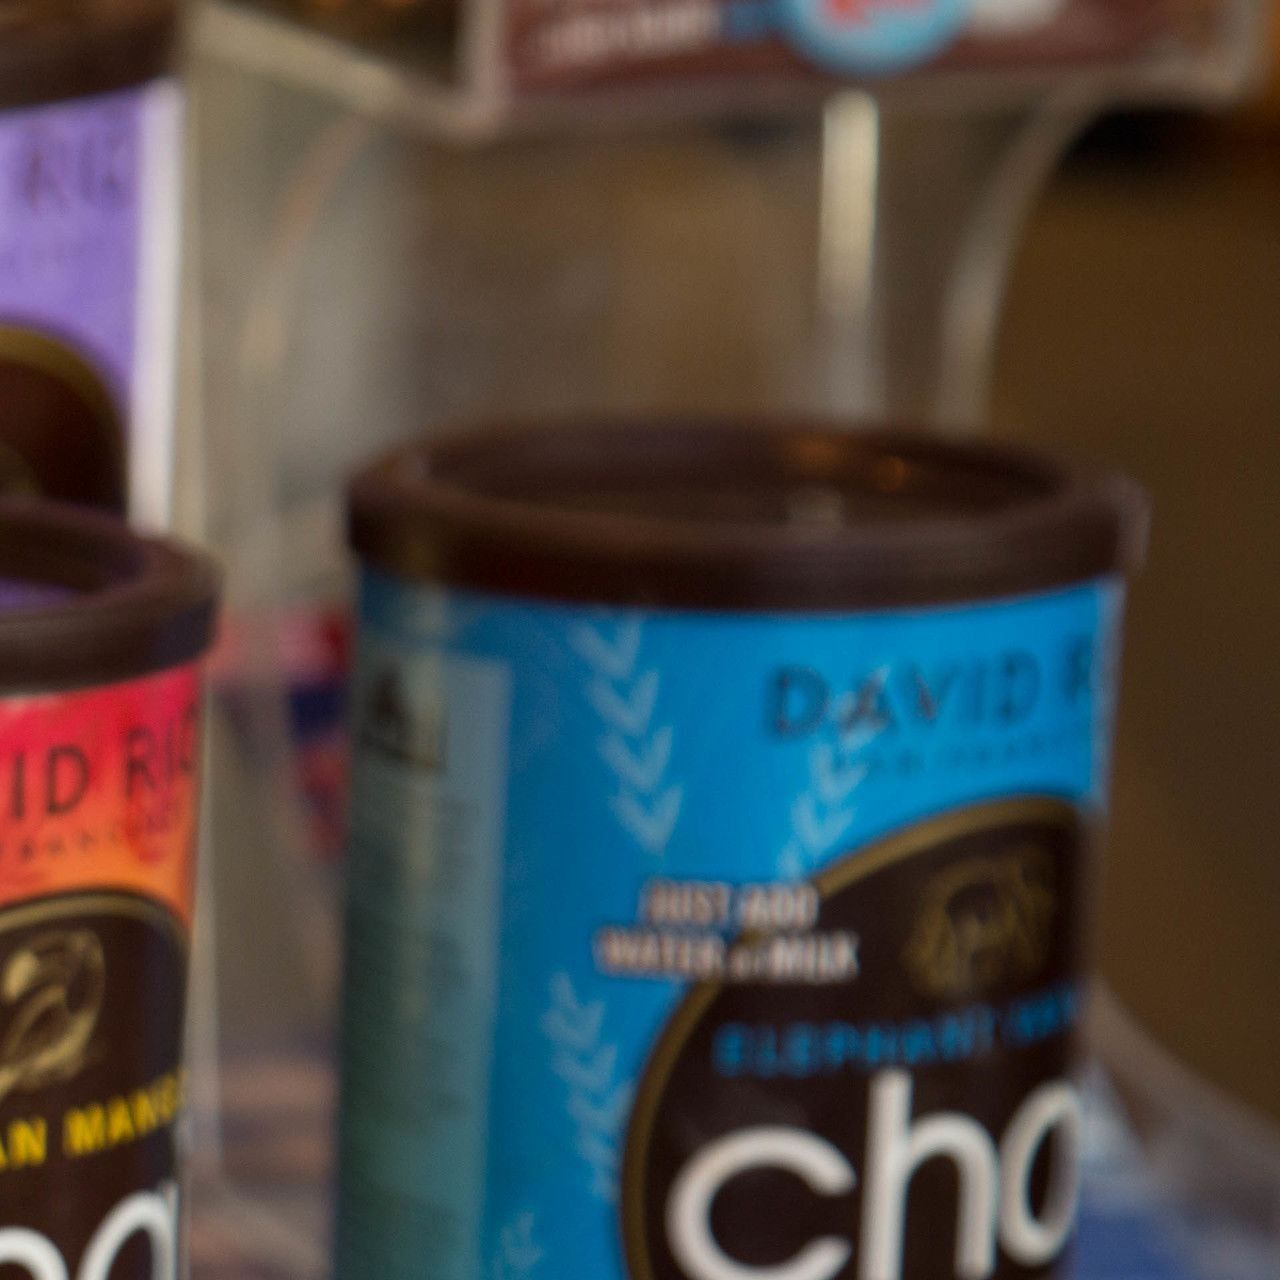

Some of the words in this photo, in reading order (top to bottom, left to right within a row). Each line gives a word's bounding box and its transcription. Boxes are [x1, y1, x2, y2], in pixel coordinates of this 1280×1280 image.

[766, 652, 1040, 746] DAVID
[643, 878, 729, 930] JUST
[738, 882, 820, 932] ADD
[770, 931, 860, 983] MILK
